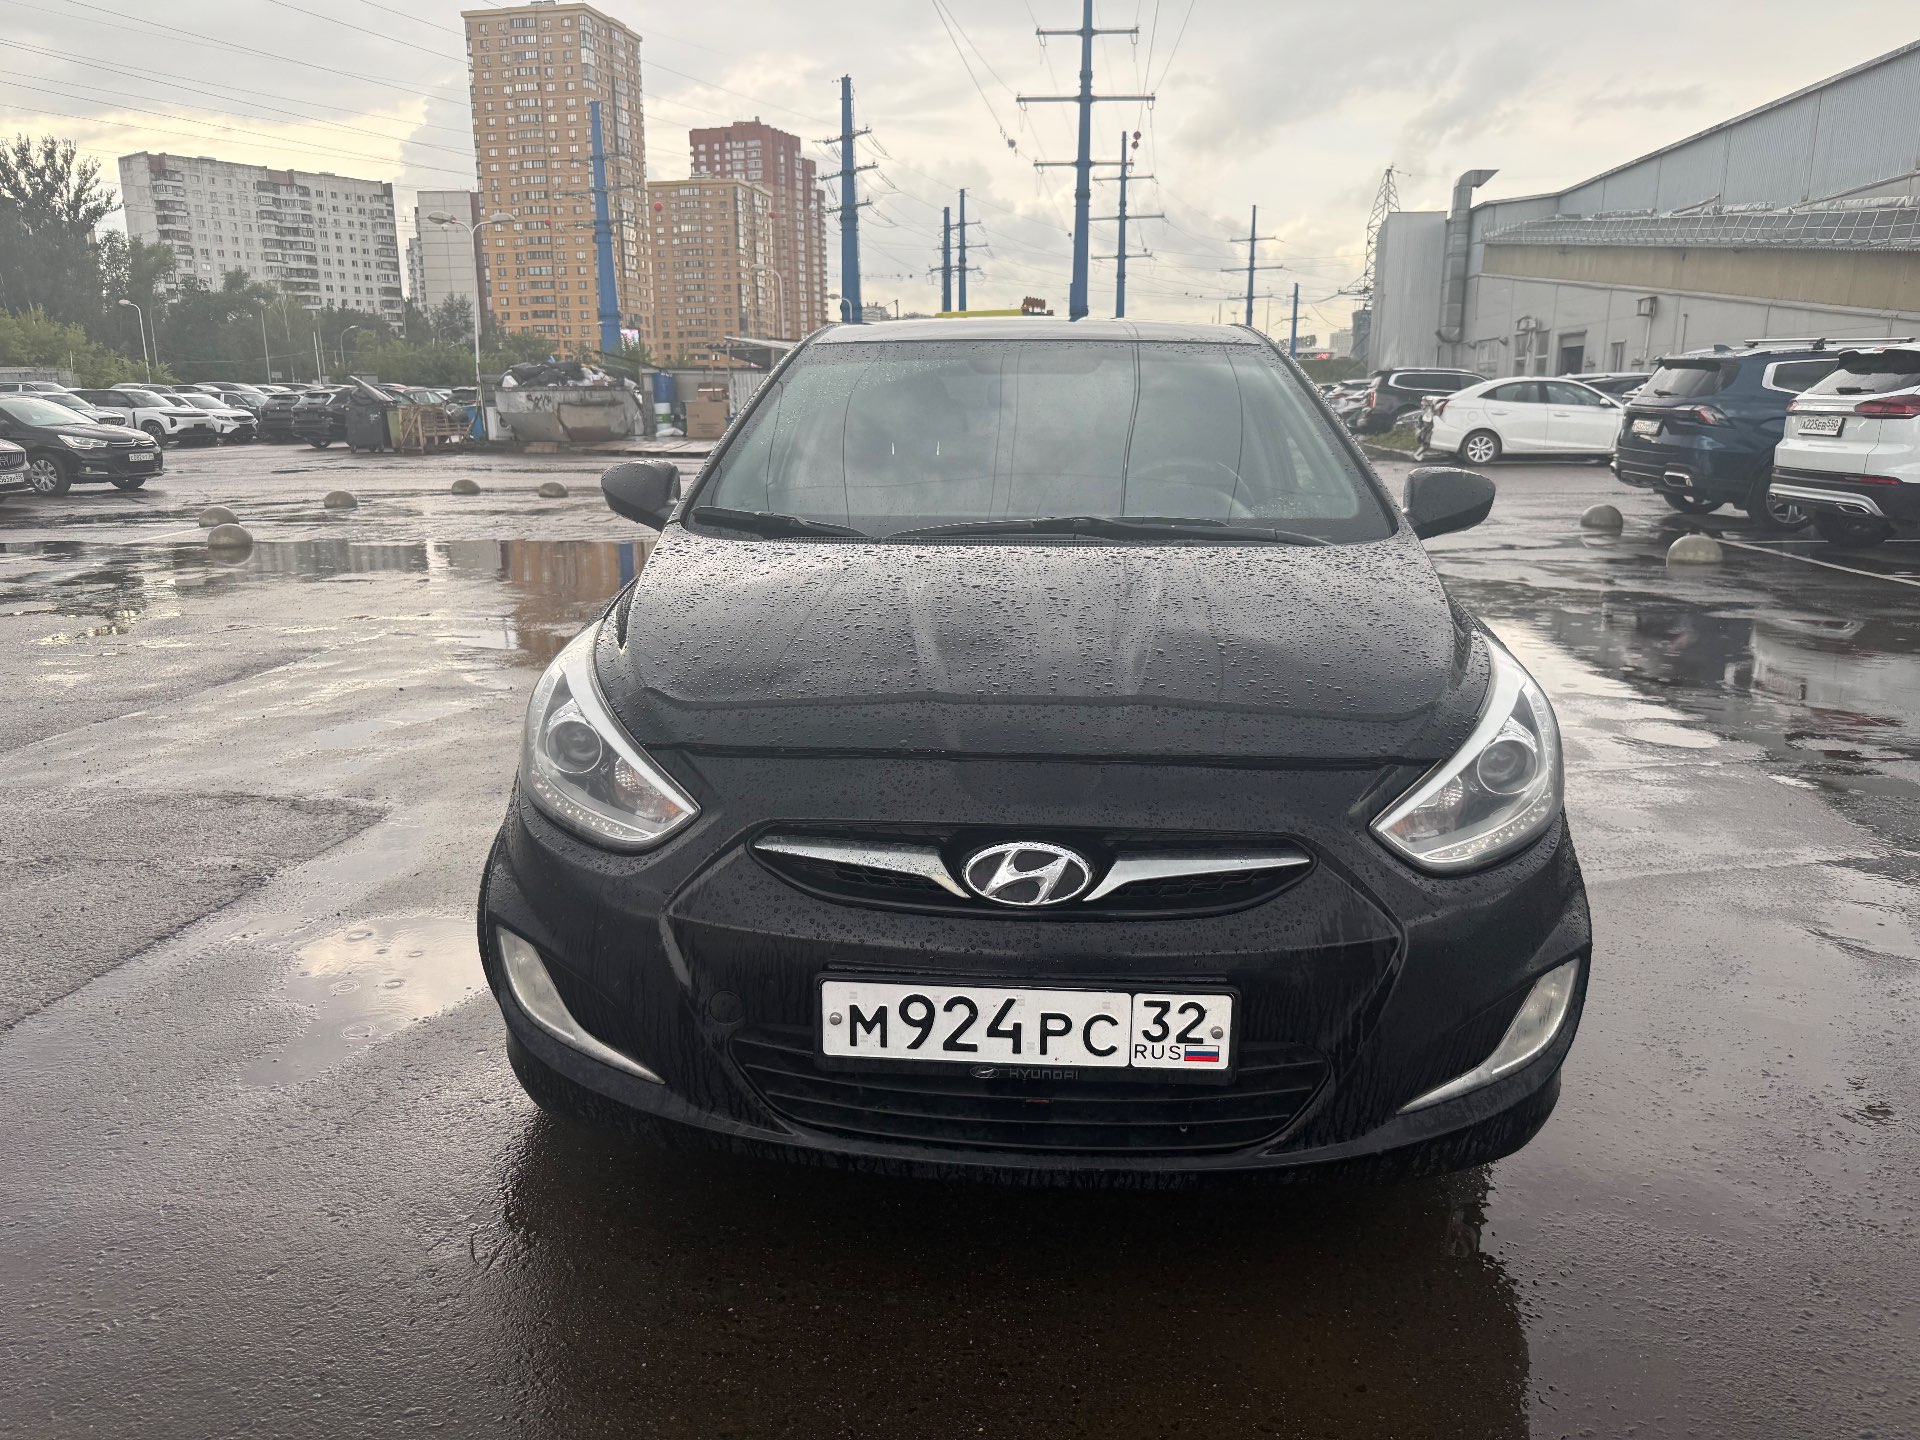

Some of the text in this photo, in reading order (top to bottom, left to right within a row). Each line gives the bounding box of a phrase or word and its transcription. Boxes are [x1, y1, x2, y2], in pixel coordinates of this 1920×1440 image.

[848, 993, 1207, 1058] М924РС 32
[1134, 1043, 1182, 1061] RUS
[1009, 1068, 1079, 1080] HYUNDAI
